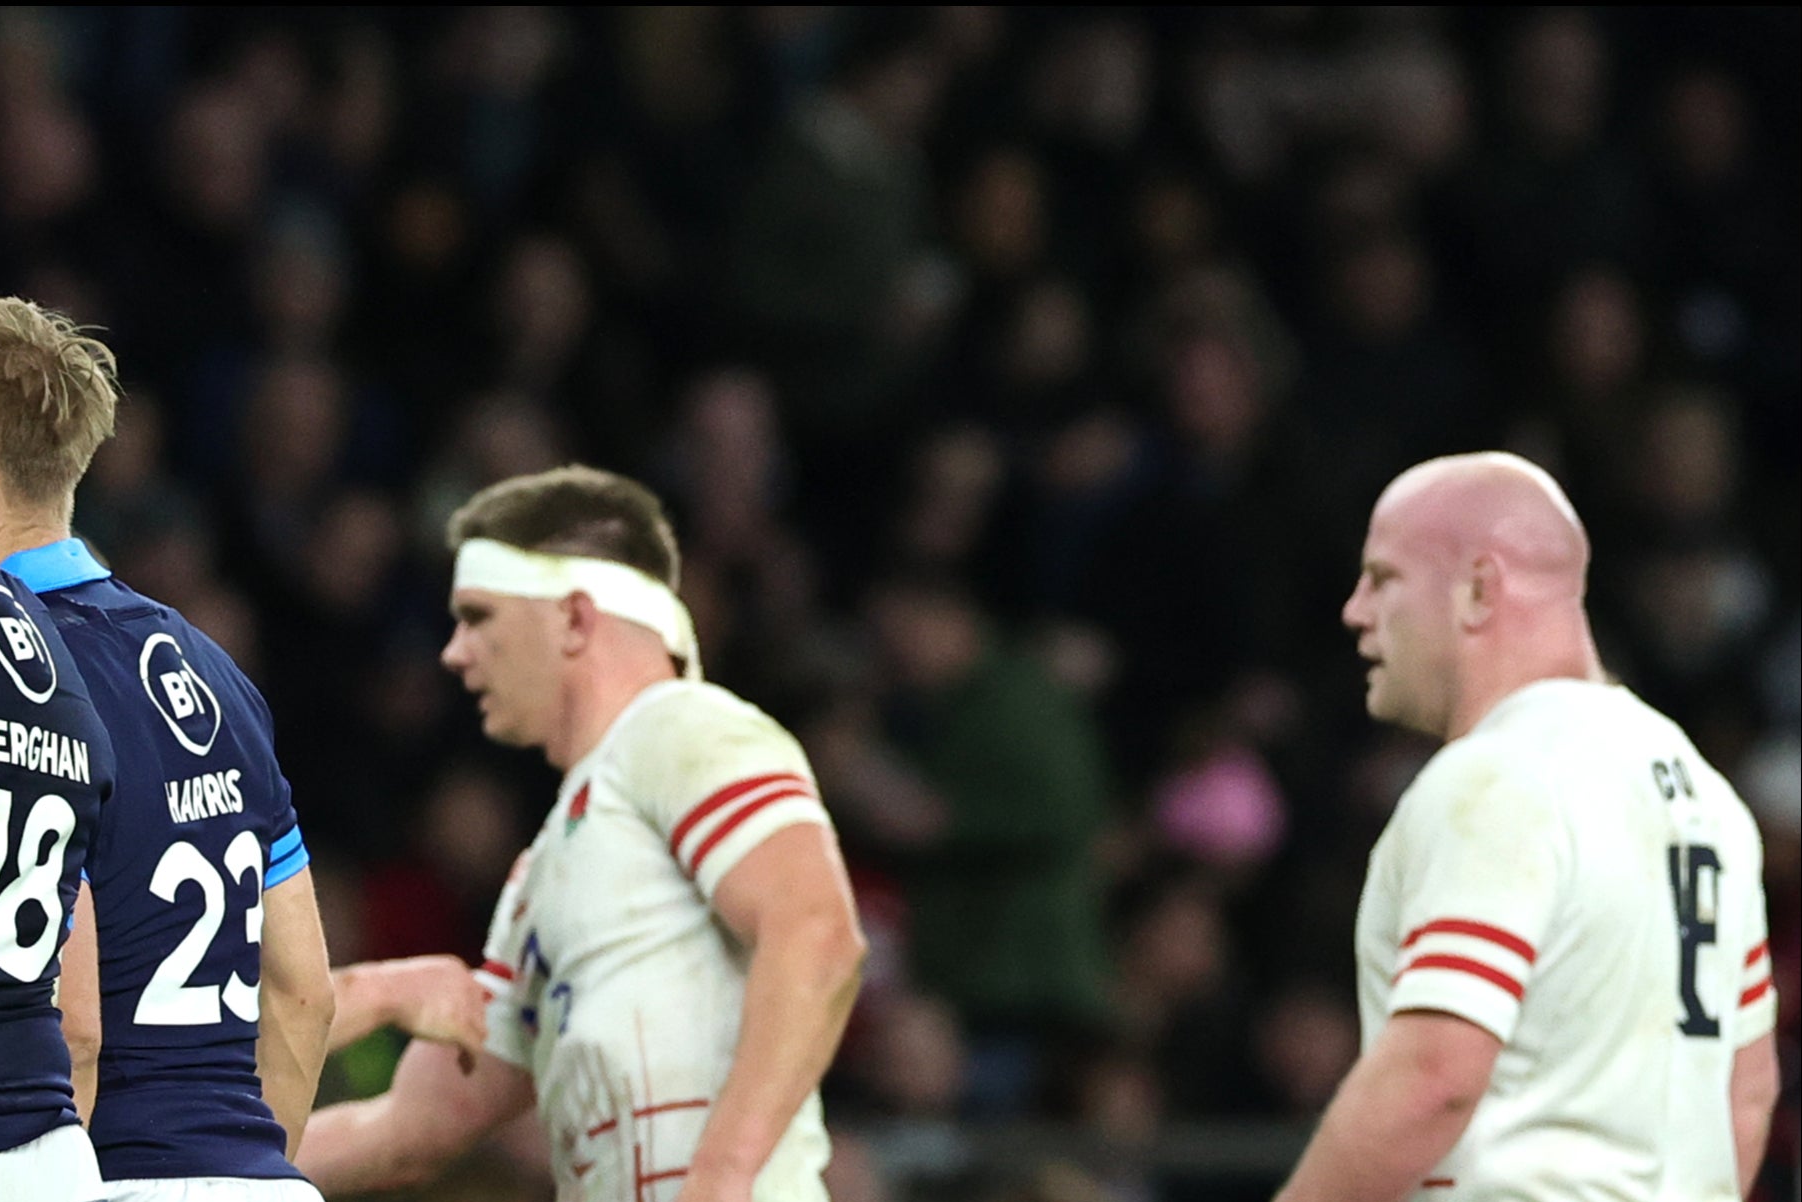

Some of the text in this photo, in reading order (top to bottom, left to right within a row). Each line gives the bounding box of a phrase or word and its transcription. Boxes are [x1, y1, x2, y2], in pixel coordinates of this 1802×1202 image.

[160, 670, 206, 719] BT
[164, 769, 244, 823] HARRIS
[133, 830, 264, 1025] 23
